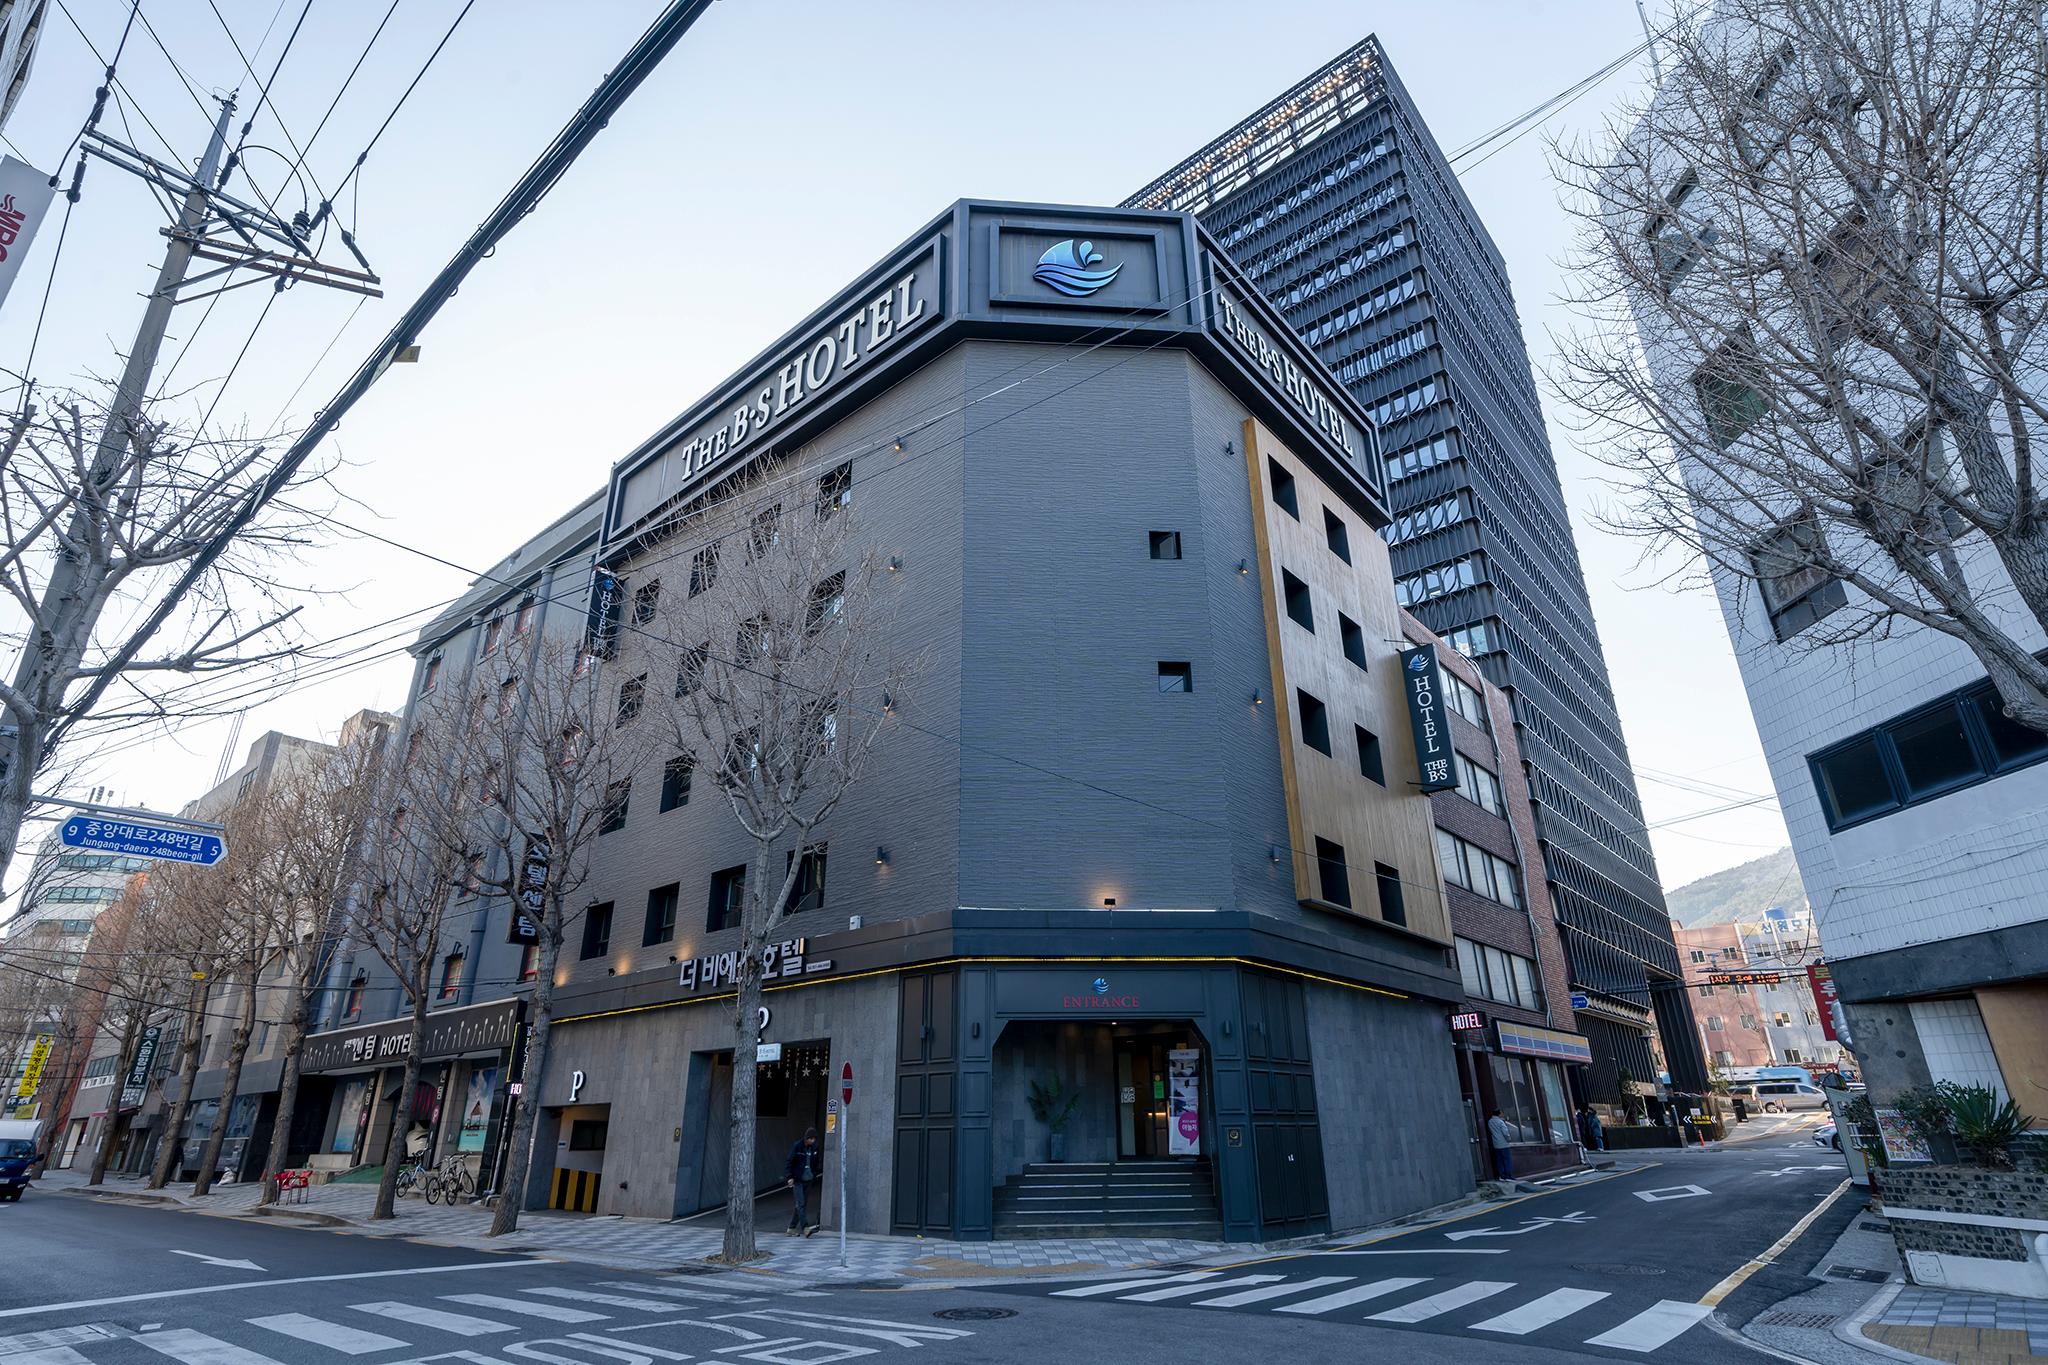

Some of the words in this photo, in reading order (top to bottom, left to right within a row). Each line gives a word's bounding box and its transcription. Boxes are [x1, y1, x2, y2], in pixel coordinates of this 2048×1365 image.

[681, 425, 728, 482] THE
[774, 273, 926, 417] HOTEL
[1219, 292, 1258, 360] THE
[1281, 353, 1354, 458] HOTEL
[1413, 675, 1440, 754] HOTEL
[1424, 758, 1448, 772] THE
[67, 824, 78, 836] 9
[85, 820, 204, 851] 중앙대로248번길
[80, 836, 149, 854] Jungang-daero
[150, 845, 203, 861] 248beon-gil
[209, 845, 219, 856] 5
[679, 957, 699, 991] 더
[760, 937, 806, 980] 호텔
[1062, 995, 1140, 1009] ENTRANCE
[1451, 1012, 1483, 1031] HOTEL
[568, 1070, 585, 1102] P
